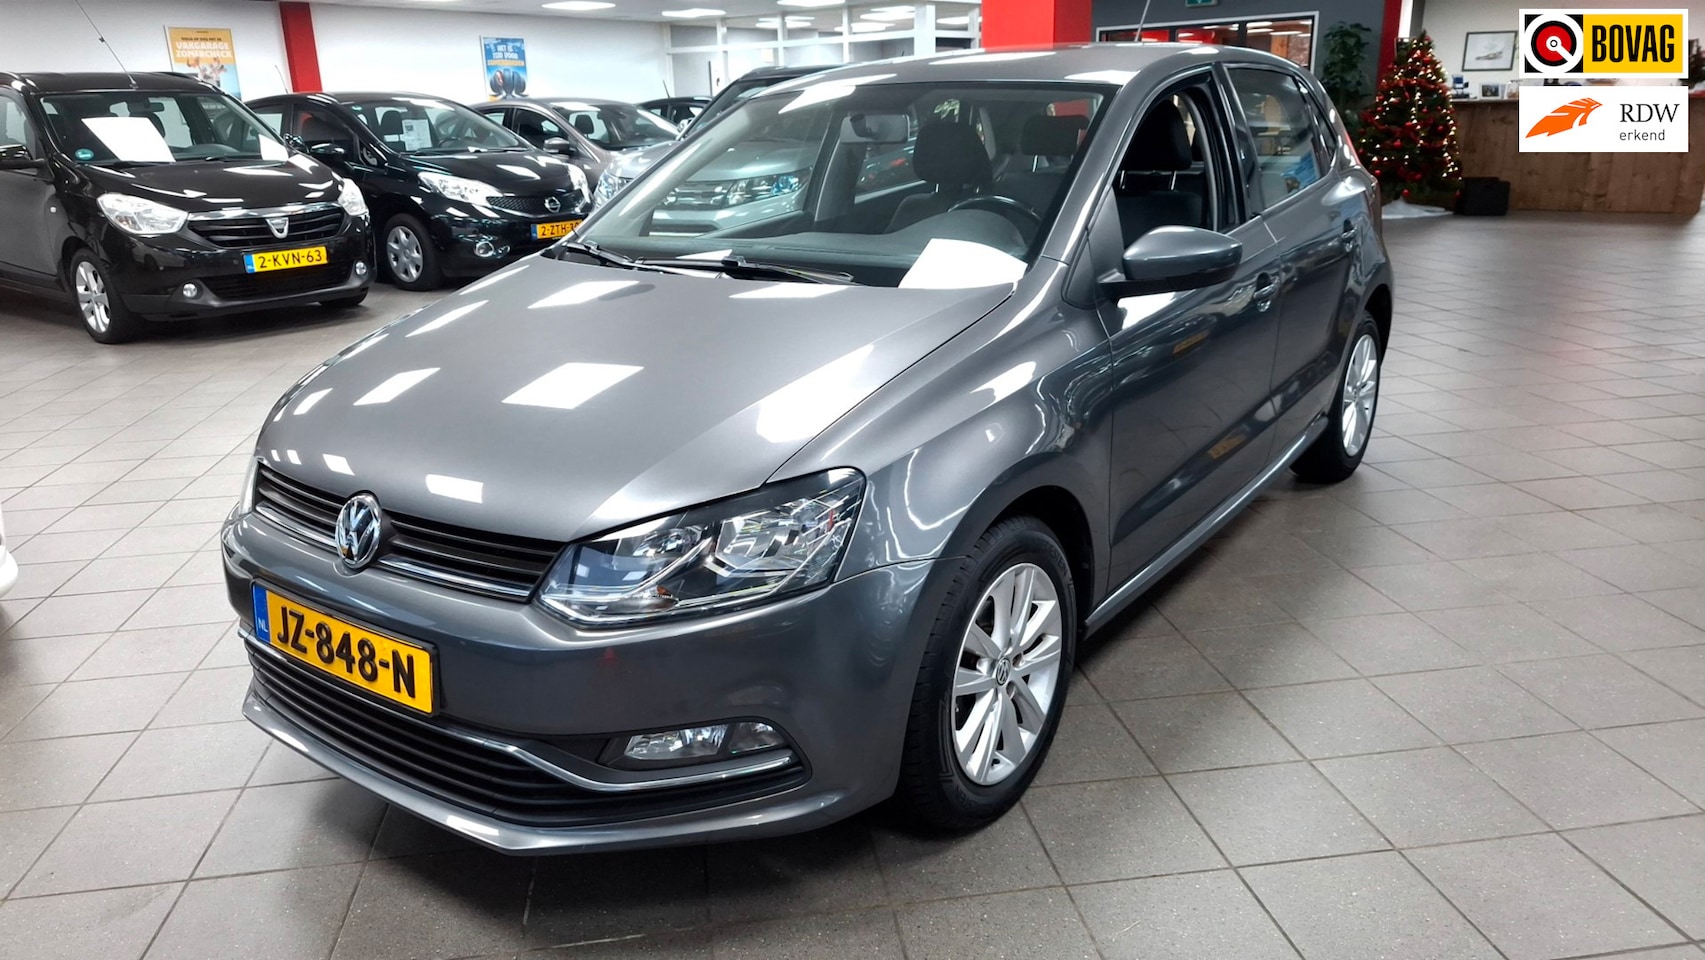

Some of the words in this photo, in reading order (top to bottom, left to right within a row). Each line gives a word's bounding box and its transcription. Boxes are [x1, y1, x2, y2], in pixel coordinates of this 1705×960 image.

[176, 41, 229, 49] VAKGARAGE
[258, 249, 322, 269] 2-KVN-63
[257, 617, 269, 633] NL
[277, 605, 416, 699] JZ-848-N
